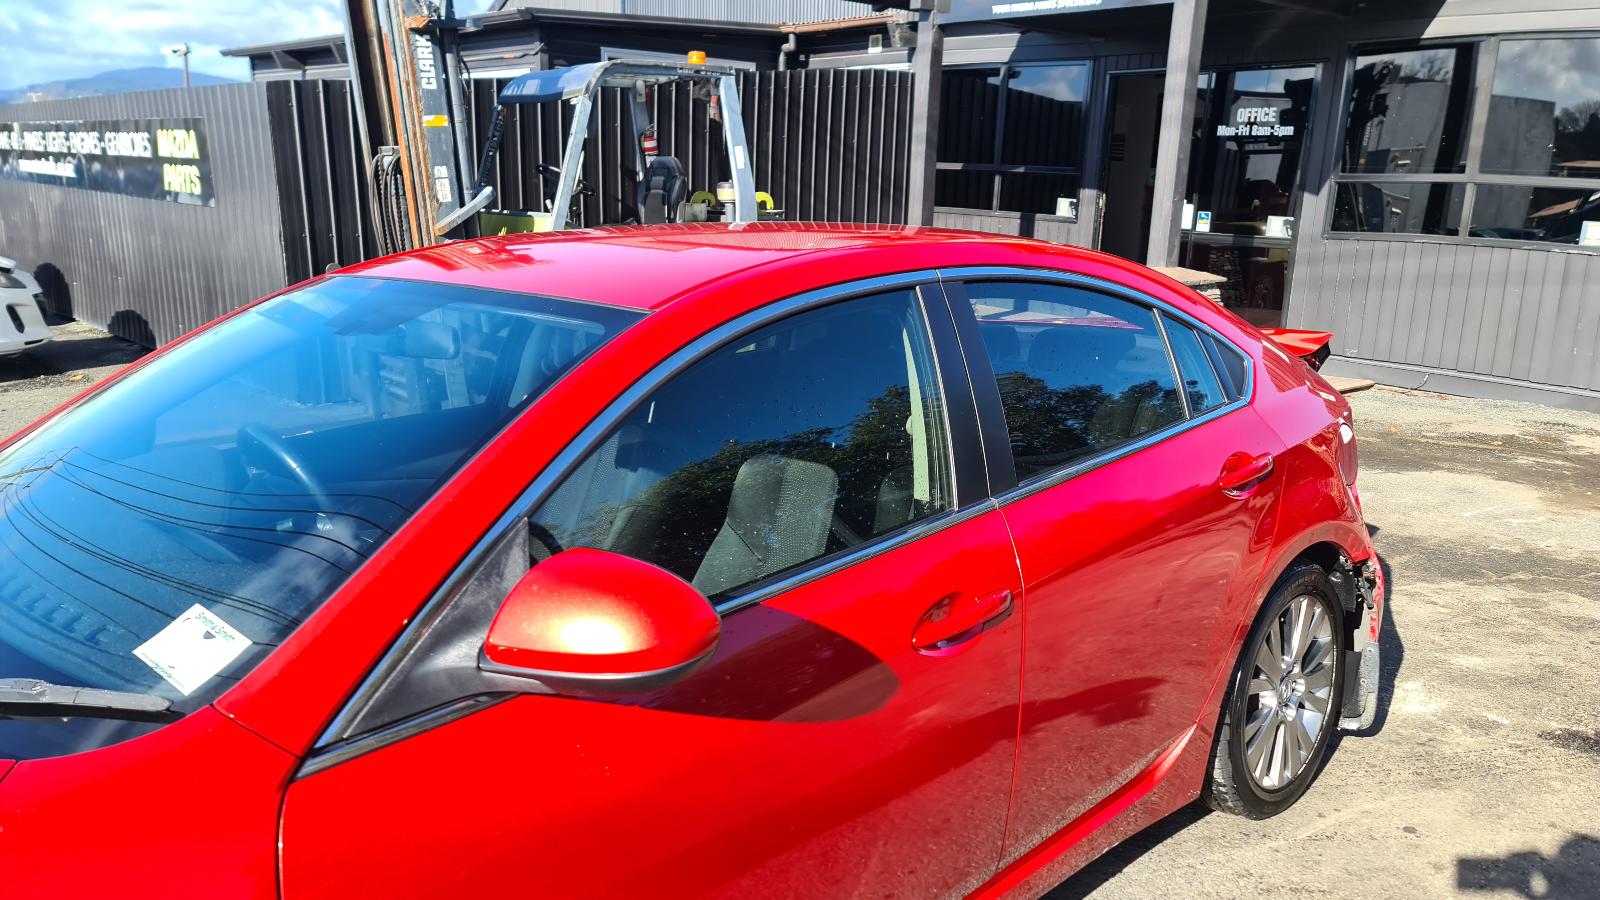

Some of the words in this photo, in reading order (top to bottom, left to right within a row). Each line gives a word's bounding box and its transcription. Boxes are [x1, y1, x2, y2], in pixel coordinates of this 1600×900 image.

[415, 34, 438, 90] CLARK
[1237, 107, 1277, 122] OFFICE
[157, 129, 200, 159] MAZDA
[1217, 125, 1250, 136] Mon-Fri
[1251, 125, 1294, 137] 8am-5pm
[163, 163, 202, 195] PARTS
